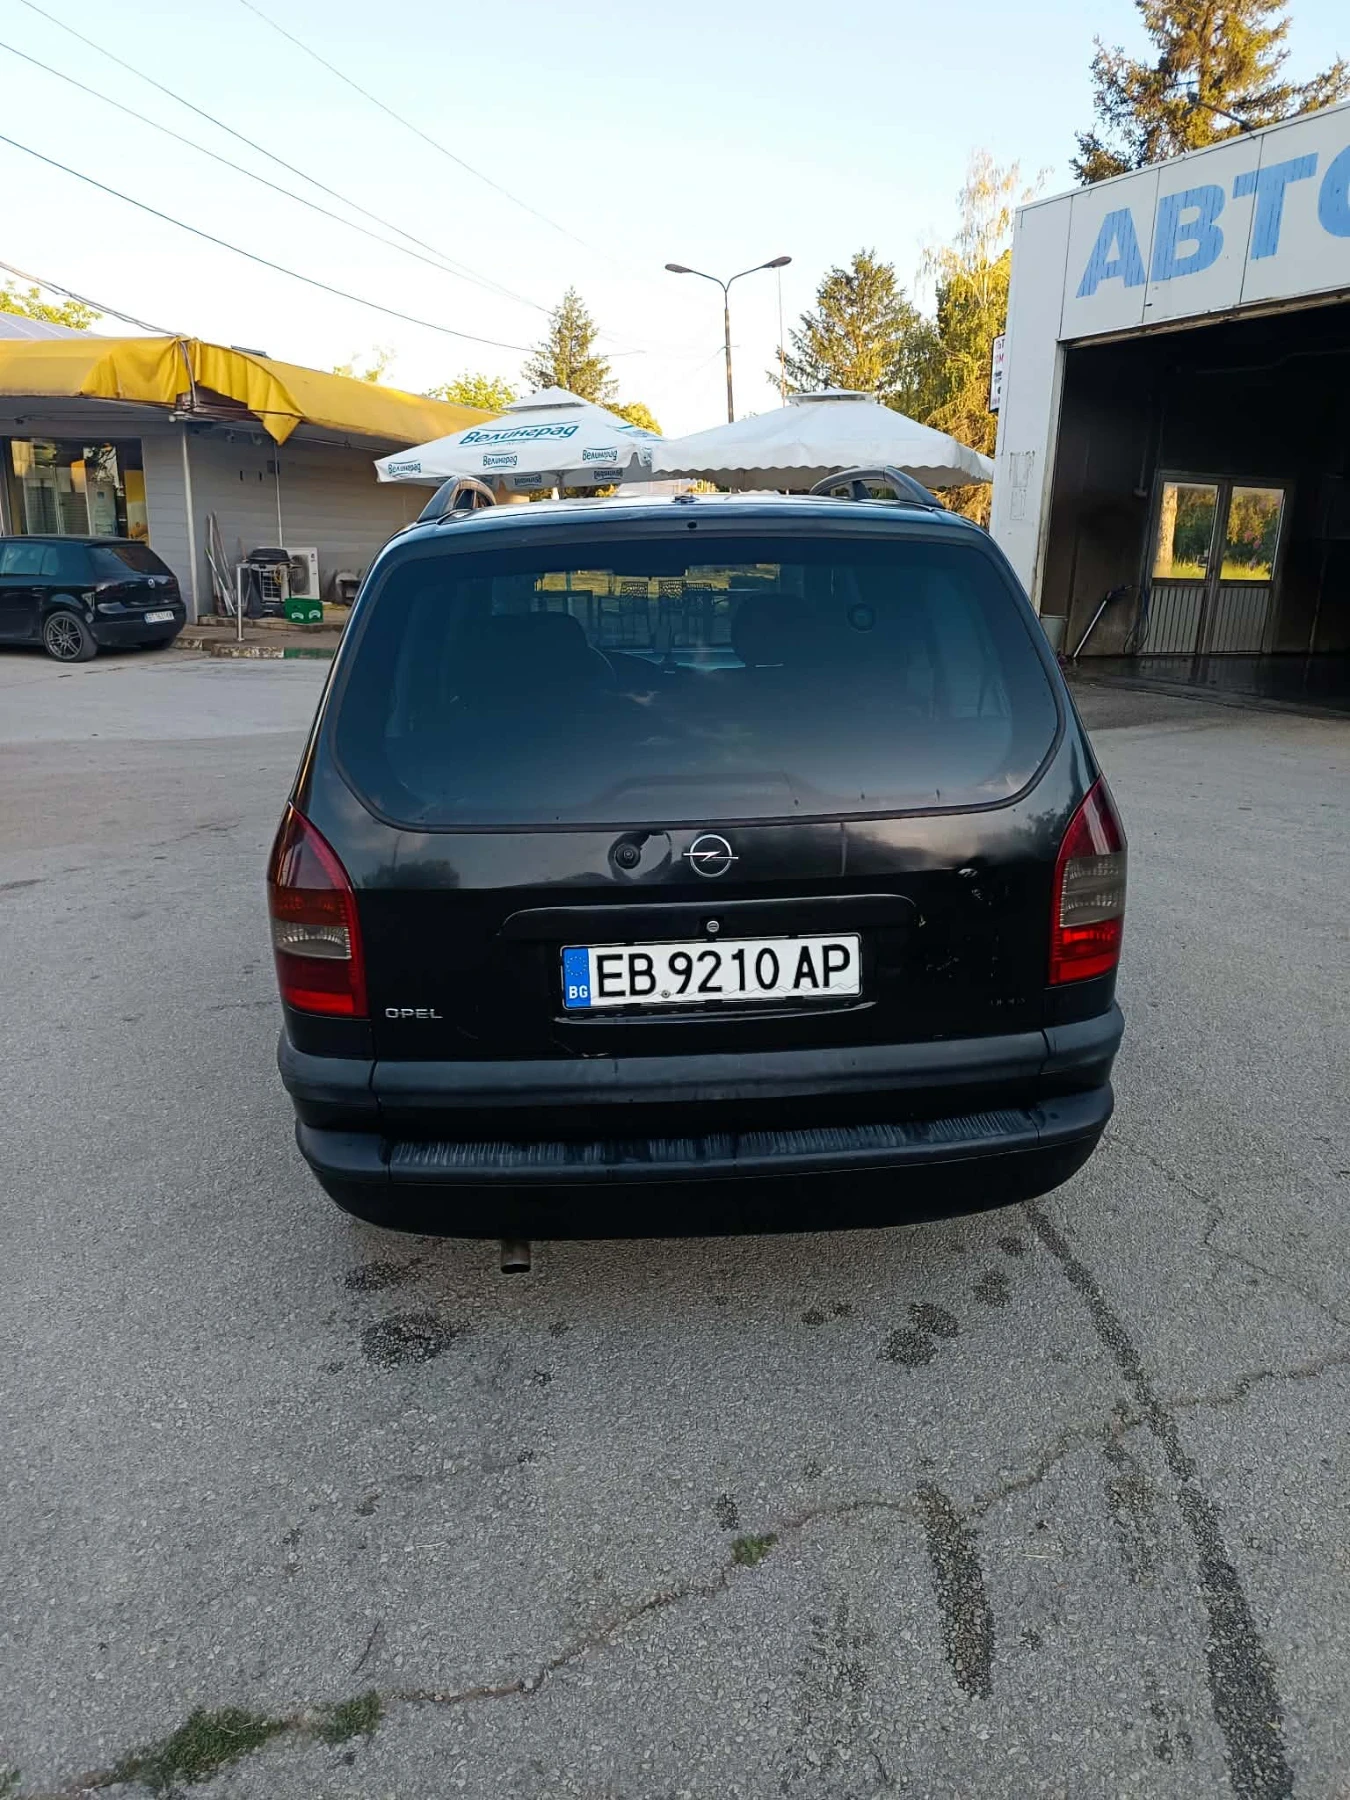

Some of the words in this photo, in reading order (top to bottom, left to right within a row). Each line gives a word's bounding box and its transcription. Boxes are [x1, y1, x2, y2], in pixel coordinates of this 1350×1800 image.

[459, 425, 579, 445] Велинград
[482, 455, 518, 467] Велинград
[596, 953, 656, 997] EB
[668, 948, 779, 994] 9210
[793, 944, 851, 989] AP
[569, 985, 588, 998] BG
[385, 1008, 444, 1019] OPEL
